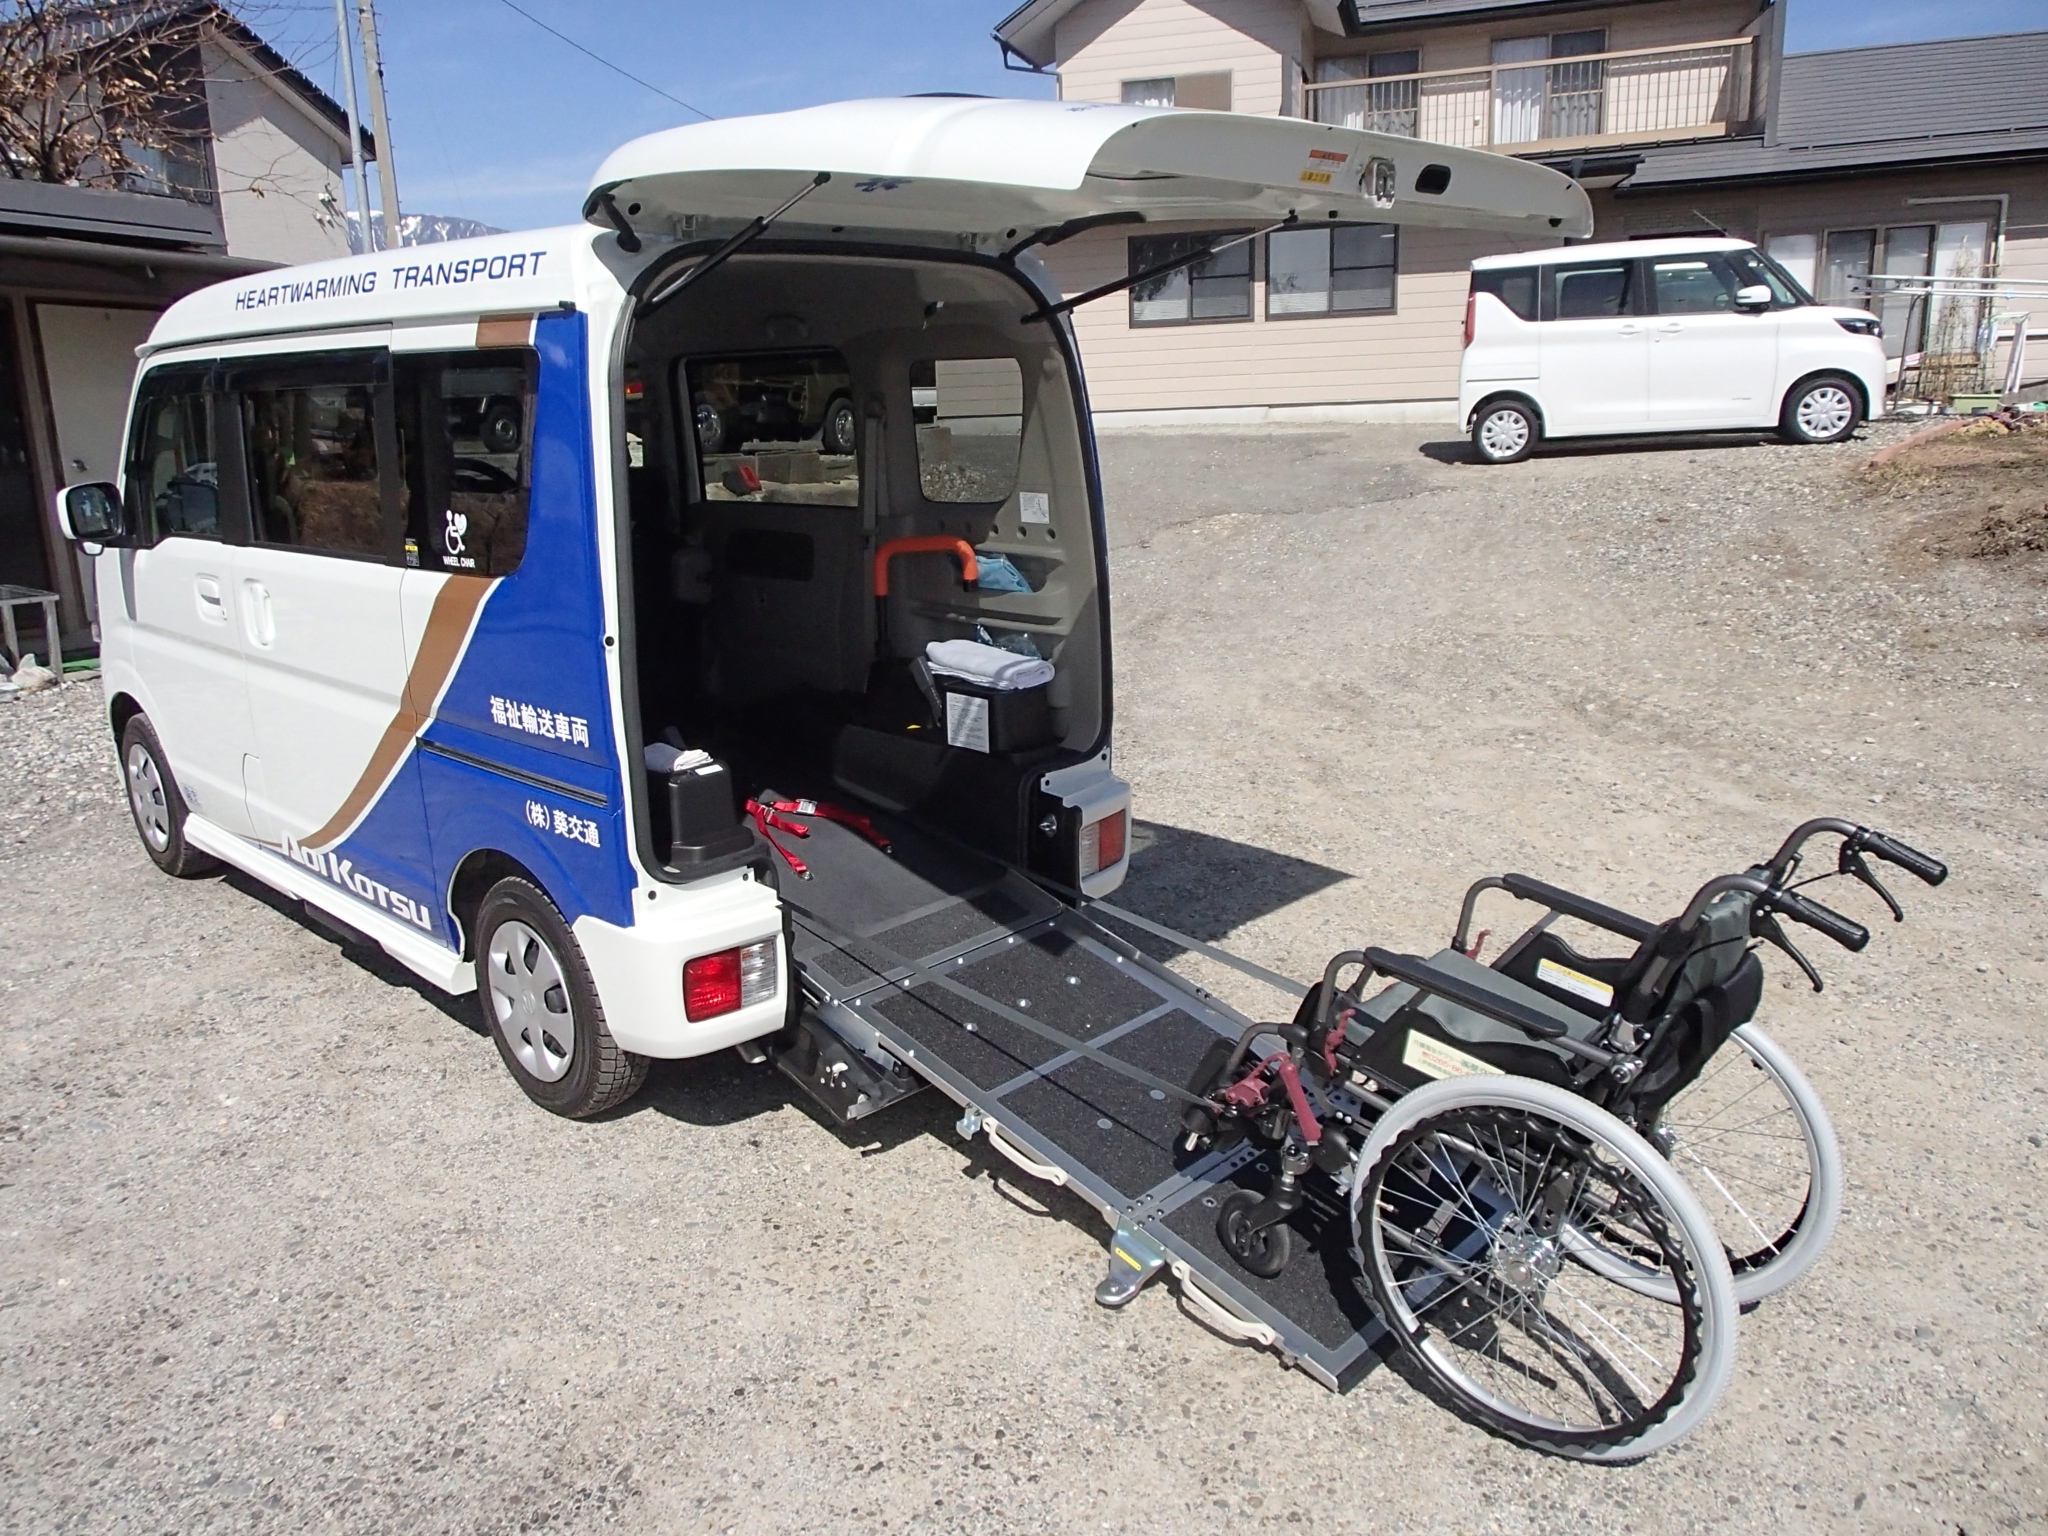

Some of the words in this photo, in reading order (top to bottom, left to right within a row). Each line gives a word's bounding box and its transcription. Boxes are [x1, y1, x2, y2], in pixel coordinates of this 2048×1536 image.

[235, 272, 377, 311] HEARTWARMING
[392, 251, 547, 289] TRANSPORT
[443, 555, 460, 567] WHEEL
[460, 557, 476, 568] CHAIR
[489, 695, 589, 748] 福祉輸送車両
